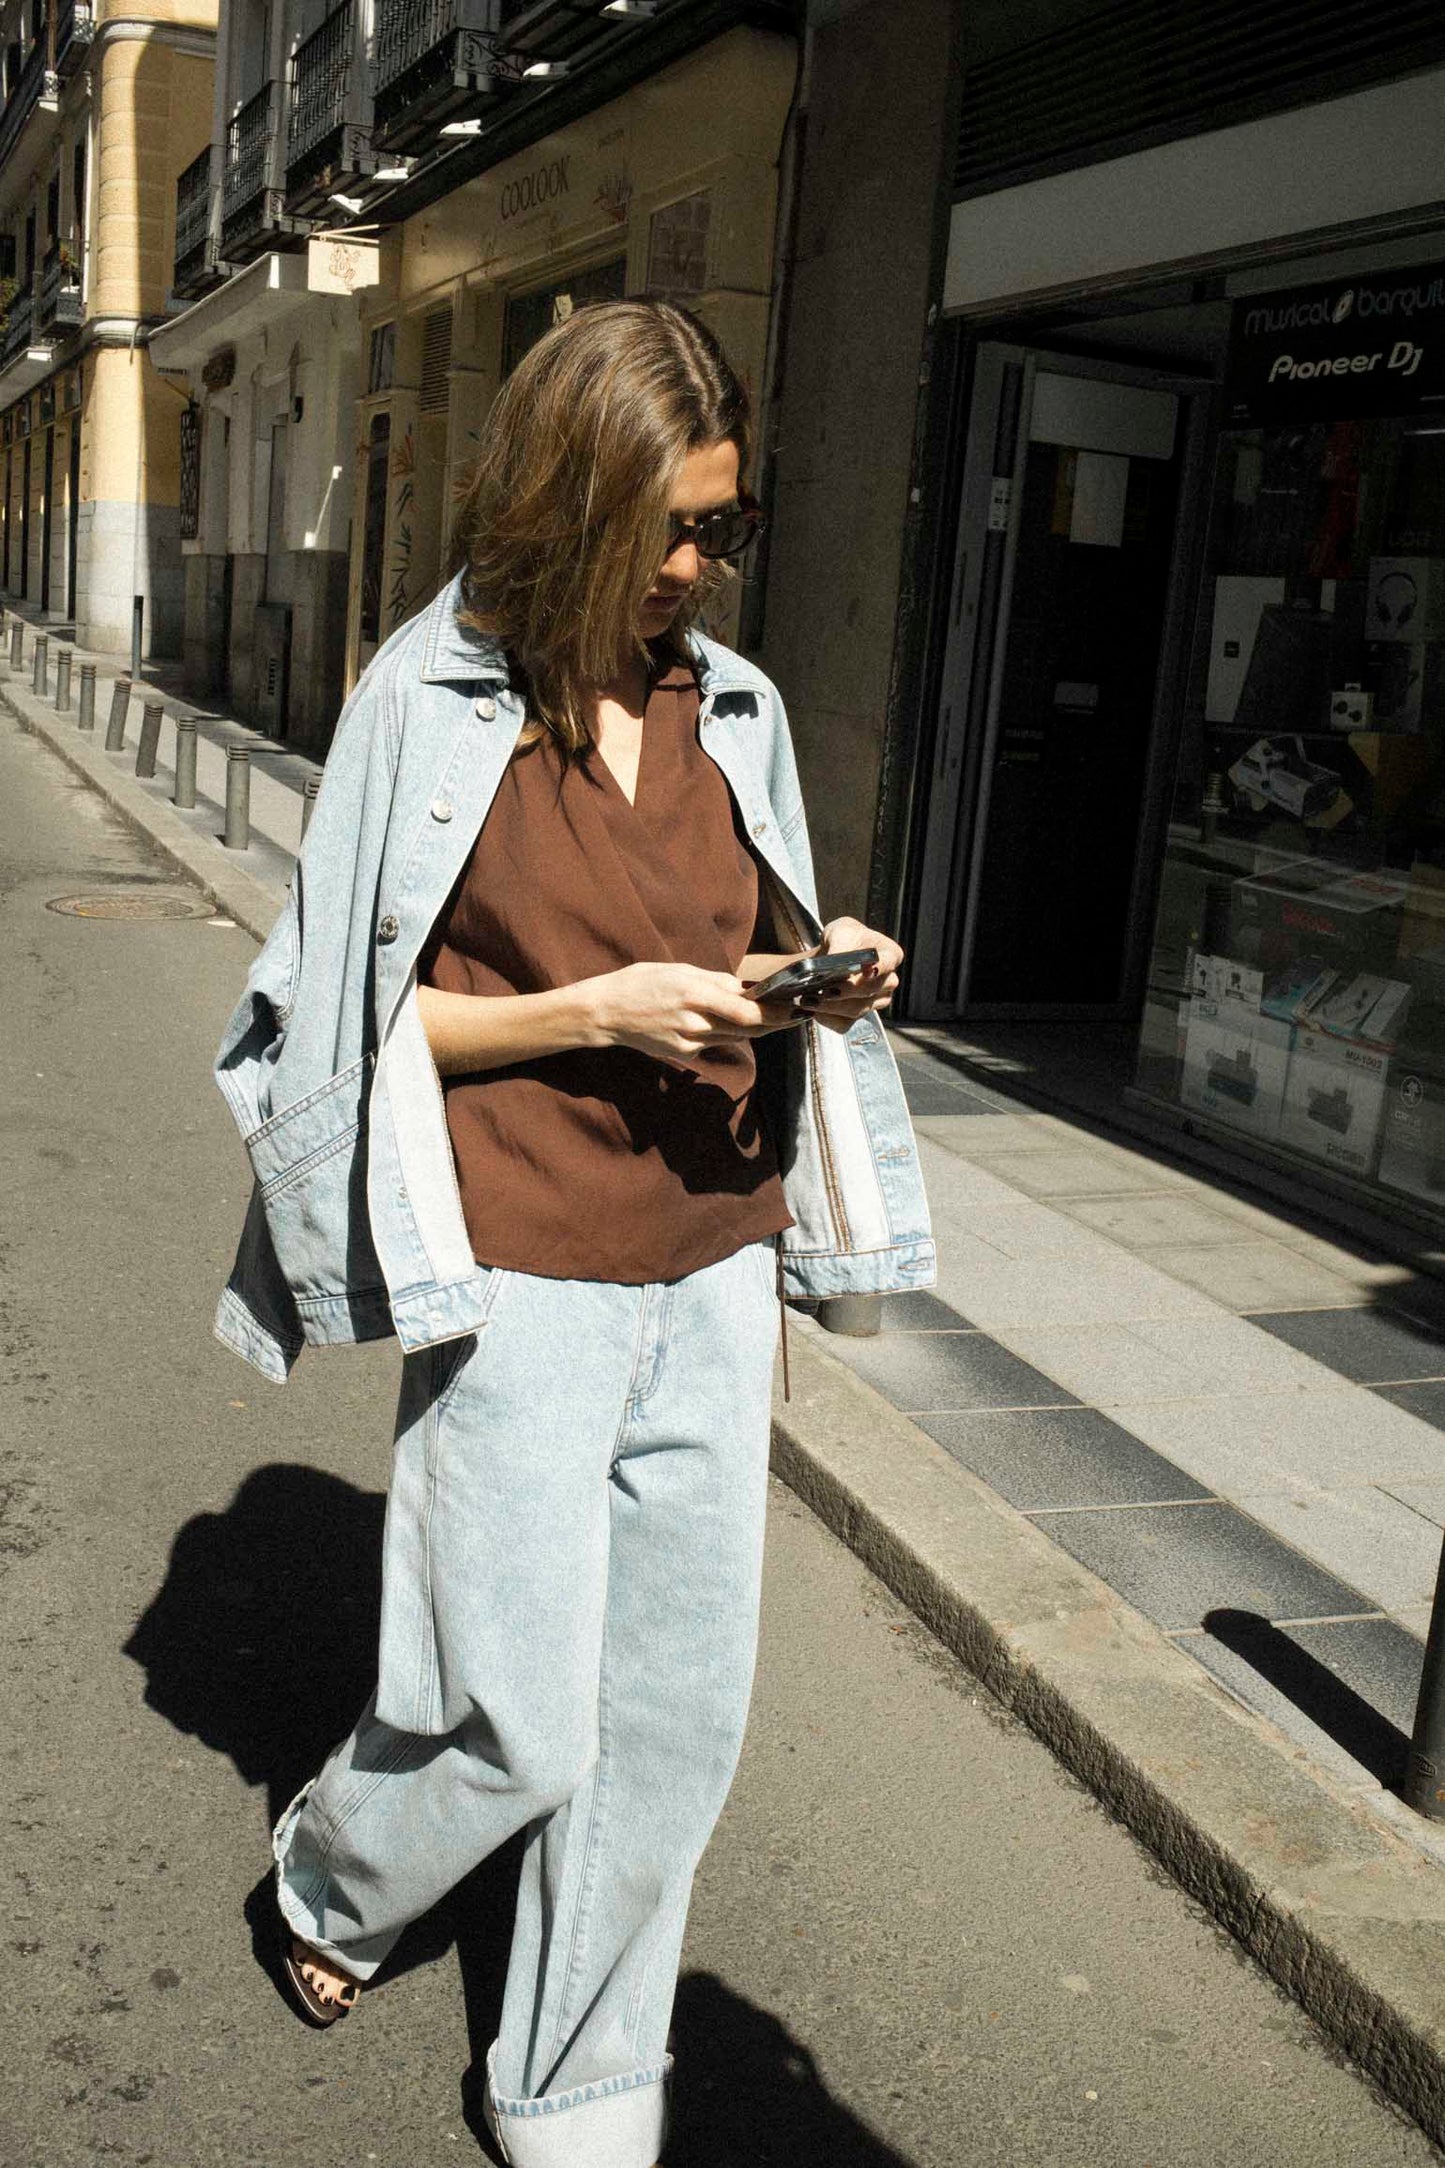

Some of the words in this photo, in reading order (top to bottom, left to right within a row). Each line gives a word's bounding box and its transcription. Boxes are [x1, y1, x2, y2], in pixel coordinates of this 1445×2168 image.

[502, 155, 571, 219] COOLOOK
[1245, 299, 1331, 335] musical
[1267, 352, 1384, 384] Pioneer
